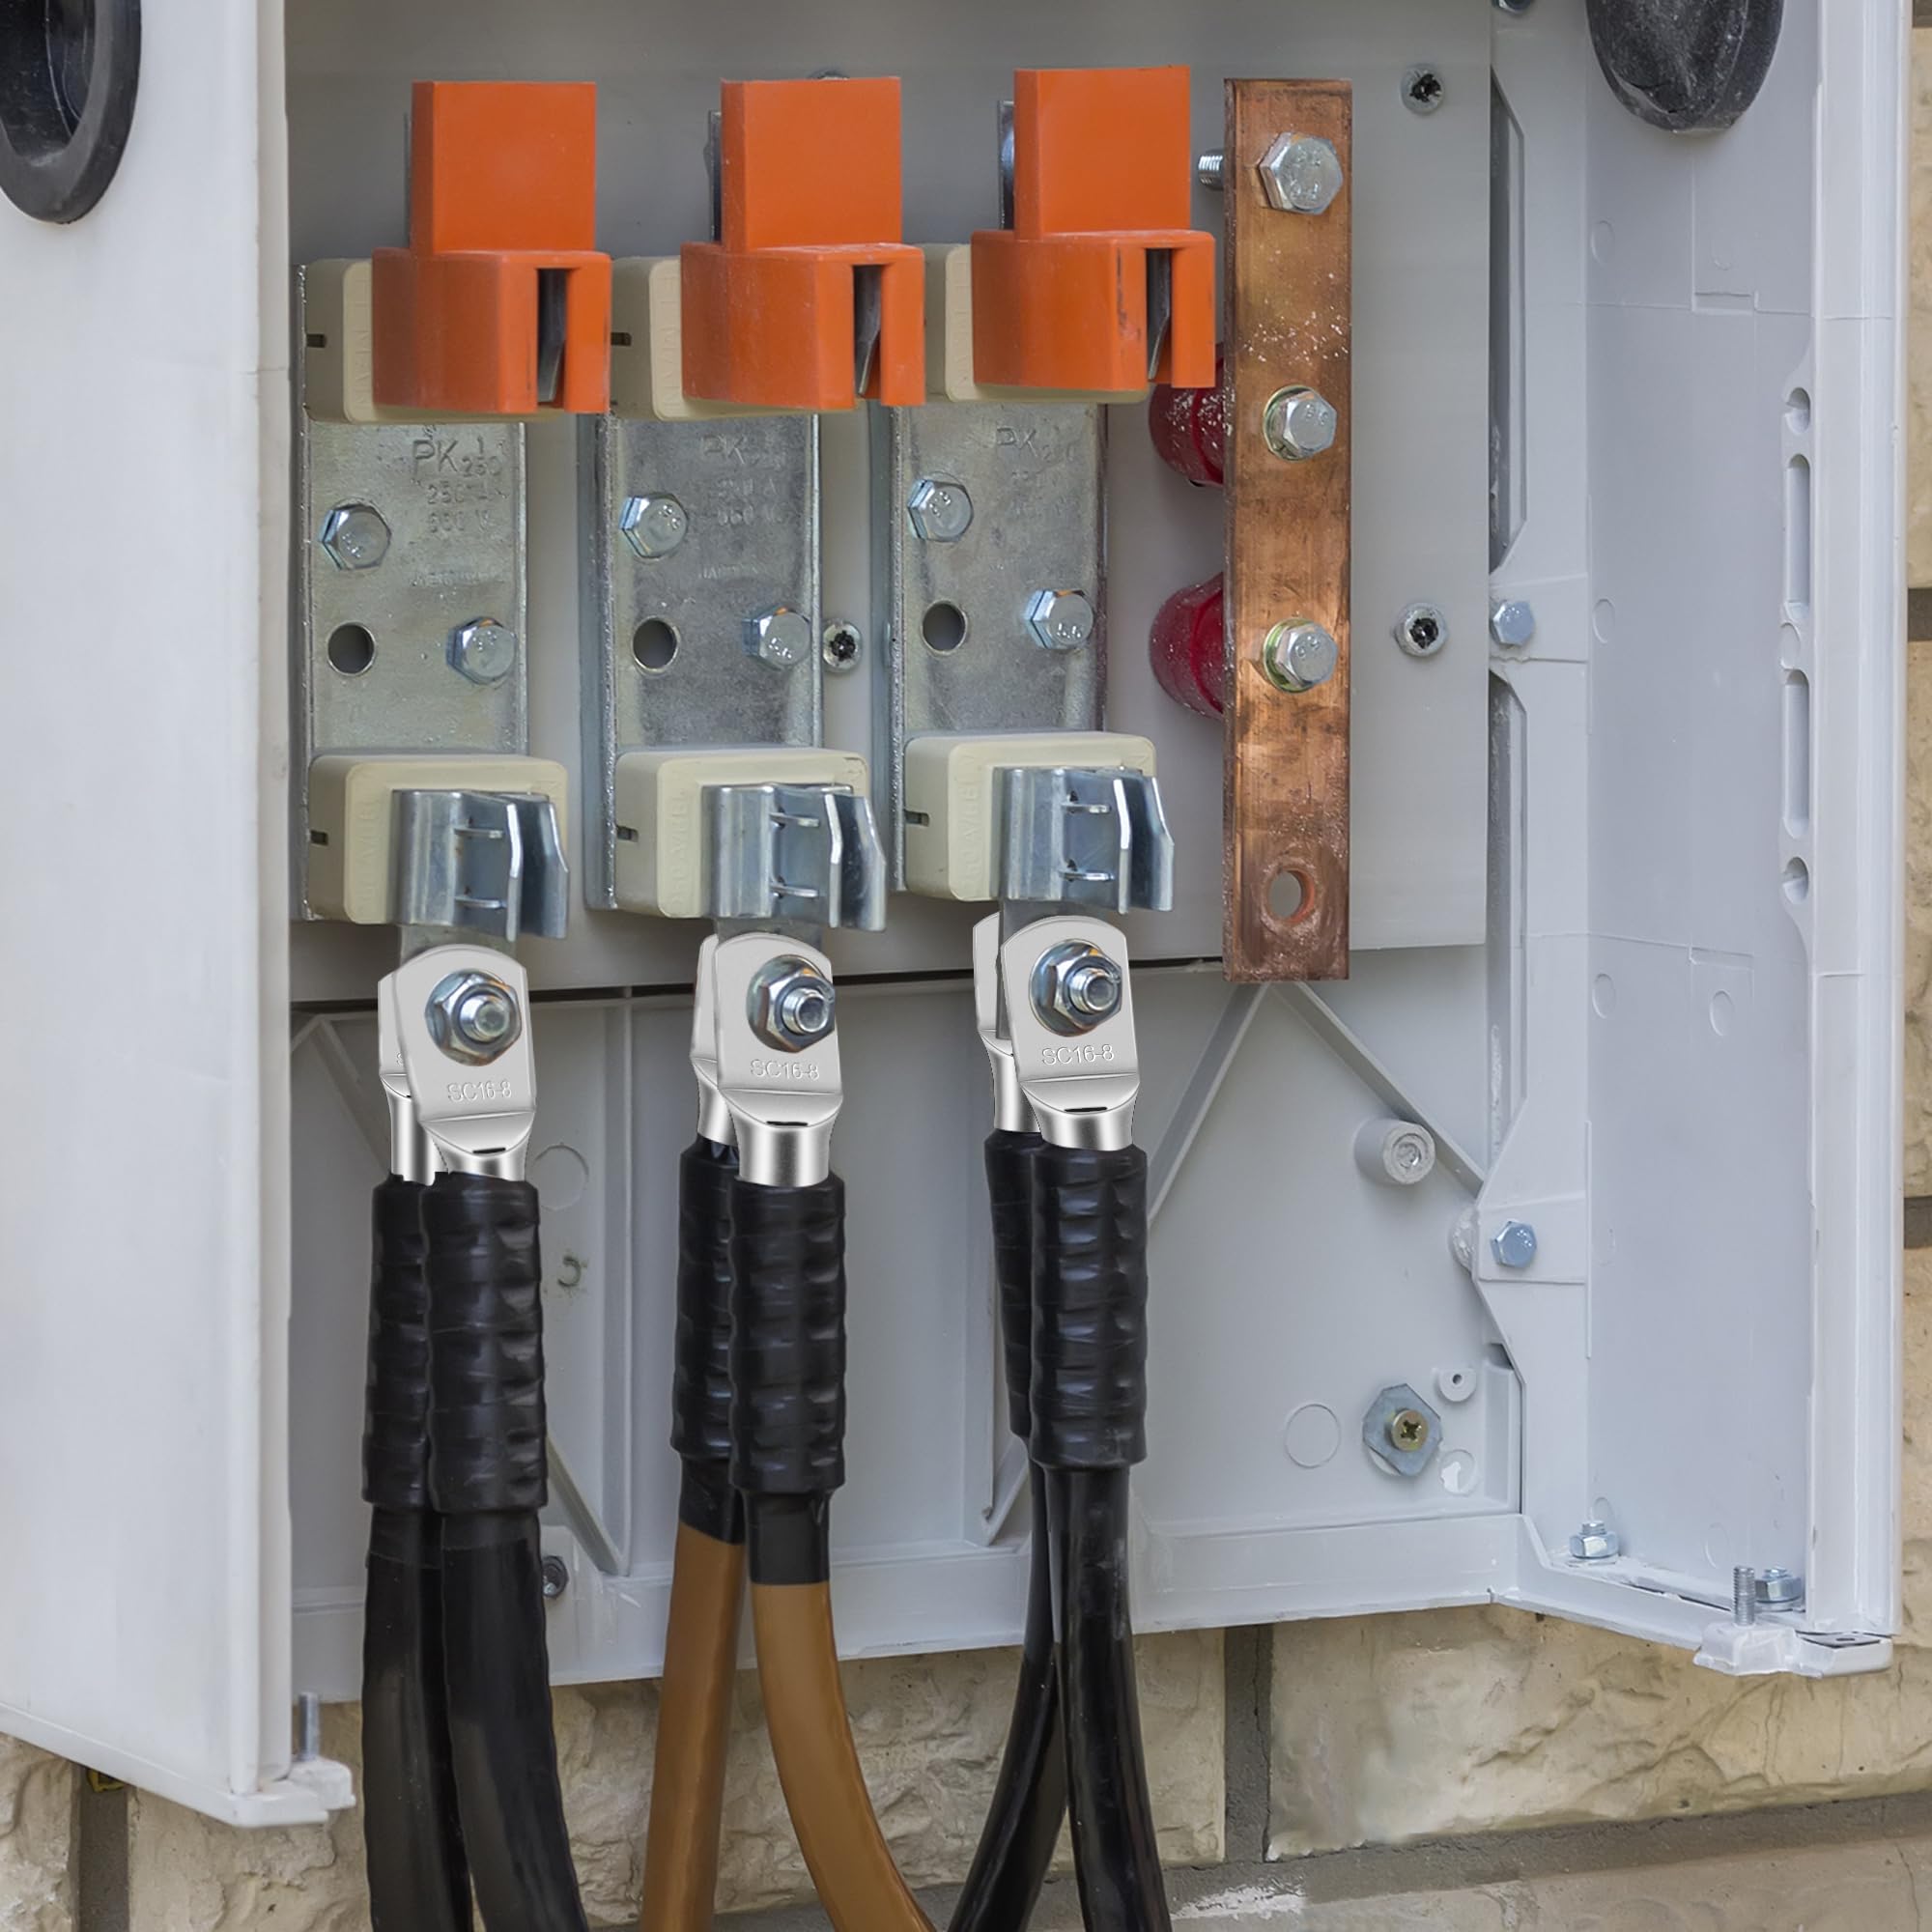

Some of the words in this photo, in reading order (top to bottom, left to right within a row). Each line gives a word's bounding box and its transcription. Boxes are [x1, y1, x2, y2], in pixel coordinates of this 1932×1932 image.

[412, 439, 459, 474] PK
[1041, 1043, 1115, 1065] SC16-8
[750, 1059, 820, 1081] SC16-8
[447, 1080, 512, 1103] SC16-8
